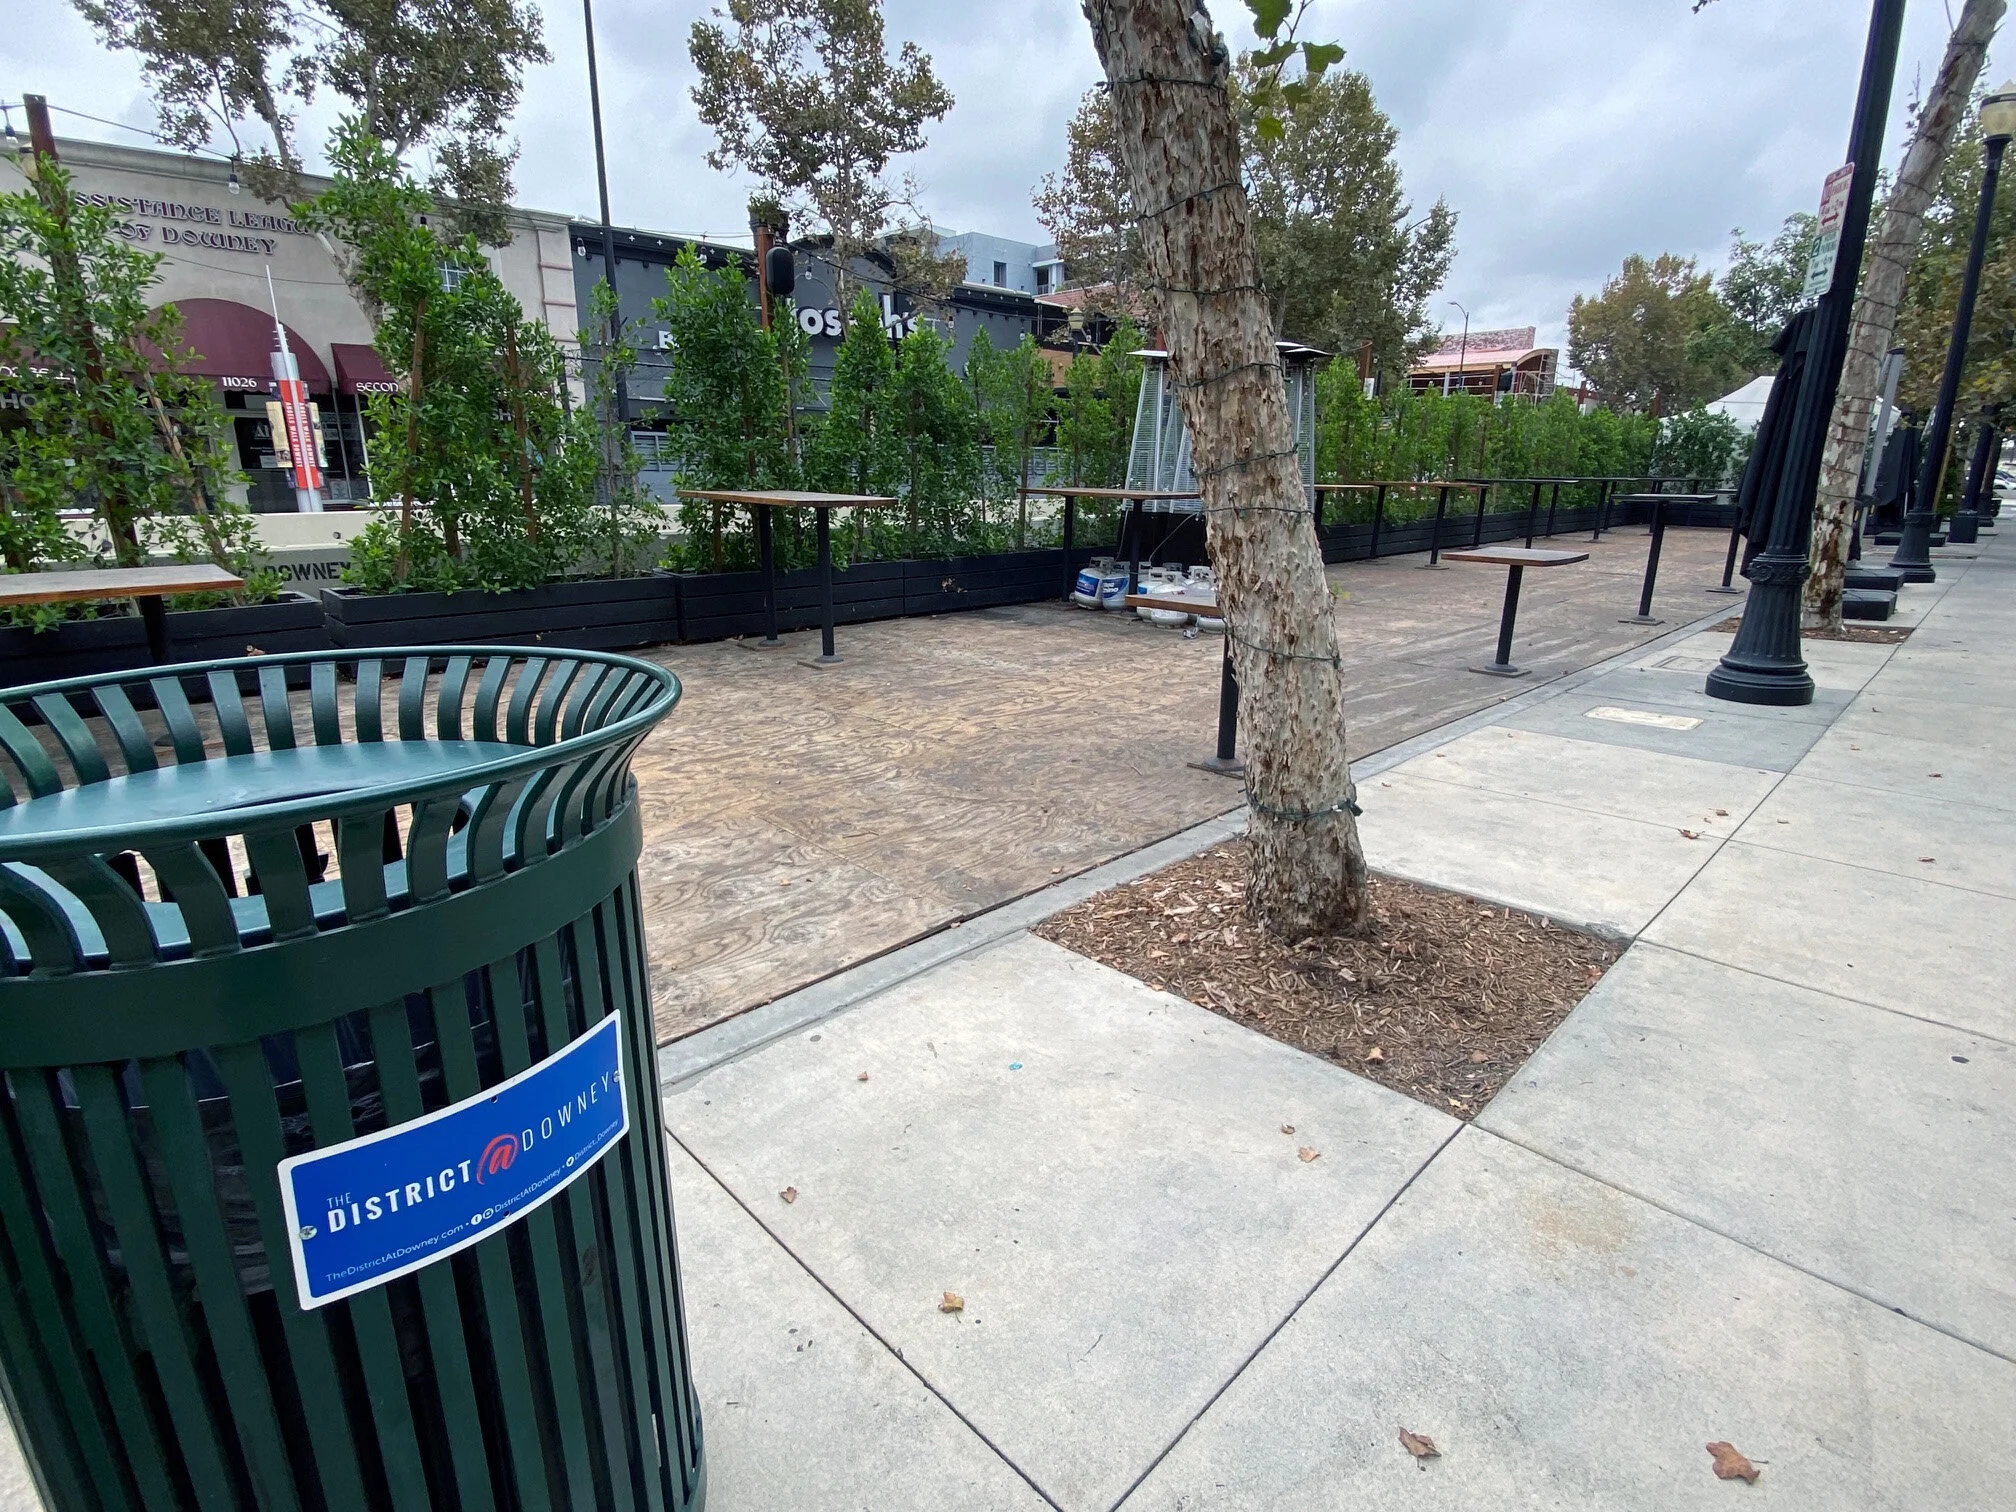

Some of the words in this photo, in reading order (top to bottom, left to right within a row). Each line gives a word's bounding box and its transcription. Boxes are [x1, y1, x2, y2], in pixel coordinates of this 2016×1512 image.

[75, 191, 222, 226] SSISTANCE
[227, 209, 311, 235] LEAGU
[161, 226, 278, 256] DOWNEY
[222, 376, 257, 388] 11026
[356, 382, 399, 392] SECON
[327, 1192, 351, 1208] THE
[326, 1224, 463, 1282] TheDistrictAtDowney.com
